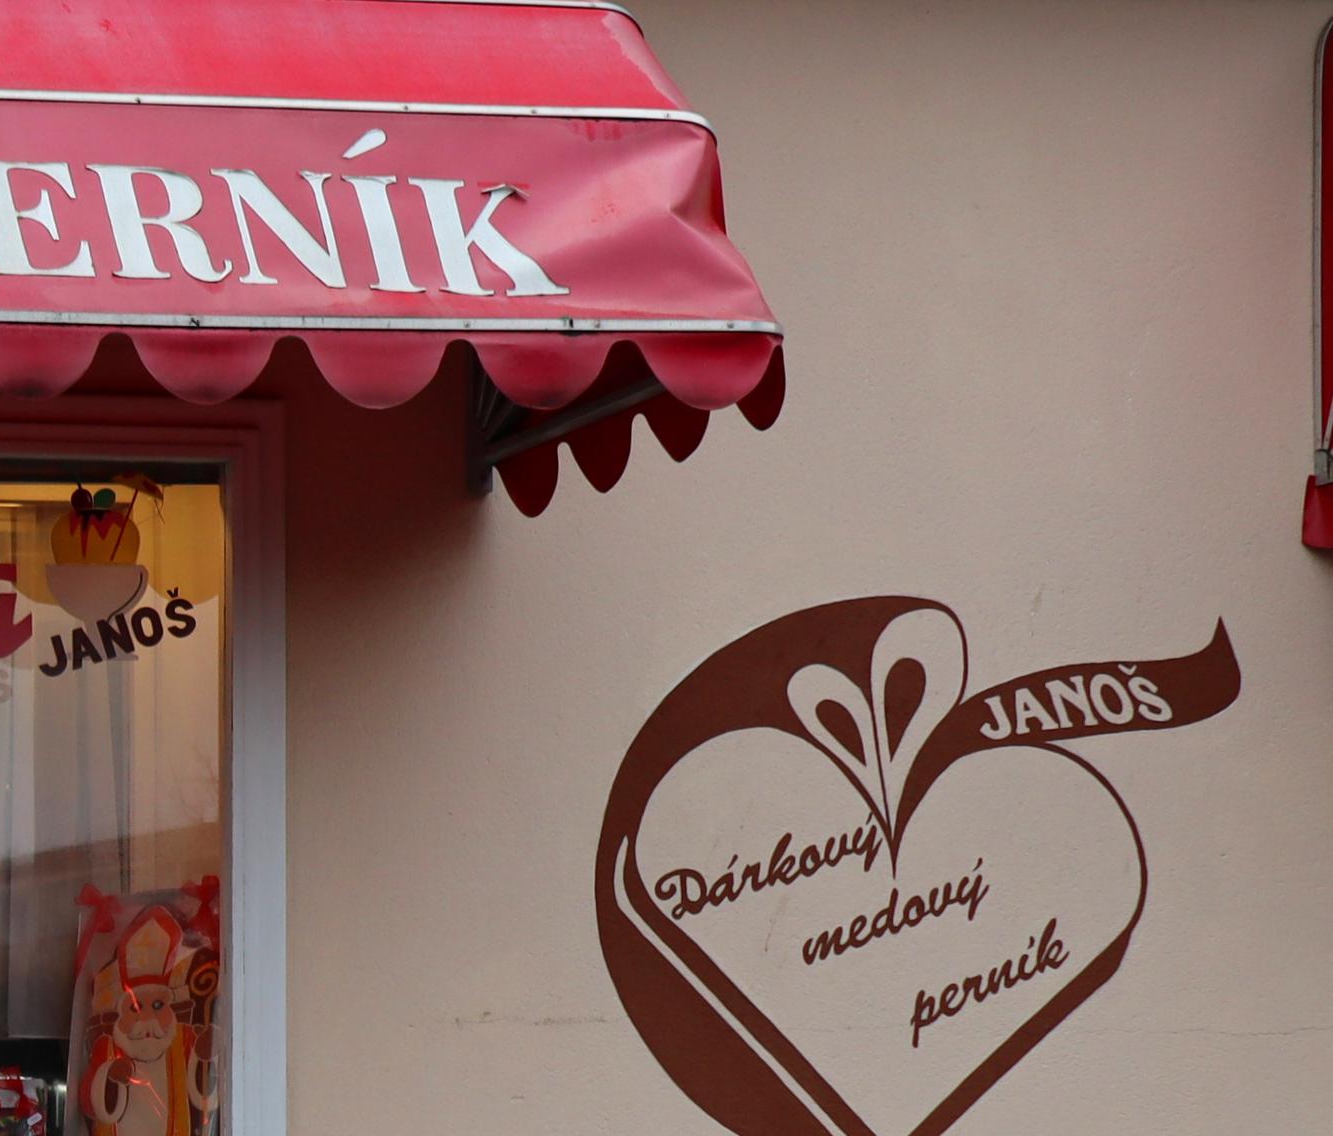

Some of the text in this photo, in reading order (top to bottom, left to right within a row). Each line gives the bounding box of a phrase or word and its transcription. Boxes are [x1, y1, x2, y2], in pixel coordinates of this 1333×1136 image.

[38, 586, 197, 678] JANOŠ
[978, 663, 1174, 743] JANOŠ
[654, 815, 883, 921] Dárkový
[802, 857, 990, 966] medový
[908, 916, 1071, 1048] perník
